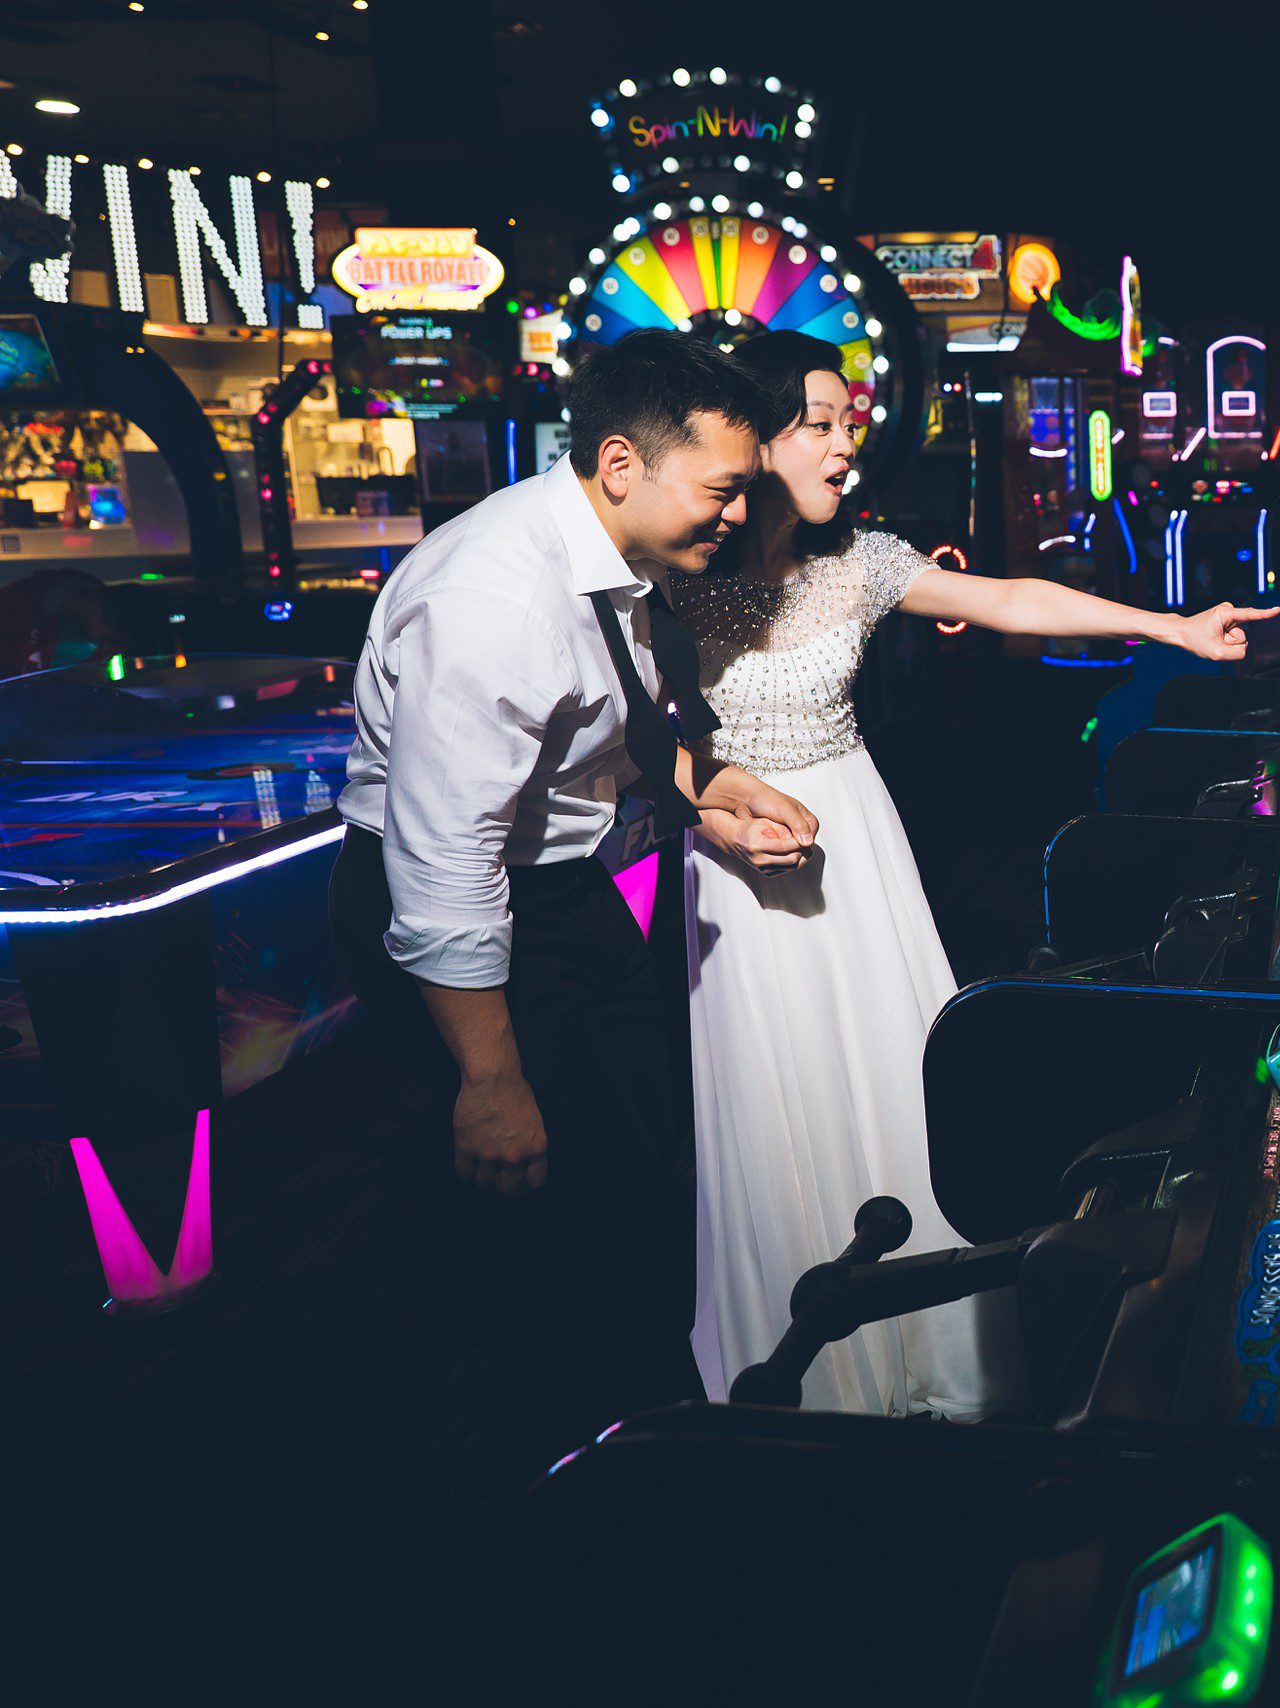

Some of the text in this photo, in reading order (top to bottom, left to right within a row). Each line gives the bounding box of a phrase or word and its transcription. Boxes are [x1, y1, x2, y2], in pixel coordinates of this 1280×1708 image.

[627, 104, 789, 150] Spin-N-Win!
[350, 260, 418, 285] BATTLE
[380, 326, 453, 340] POWER UPS
